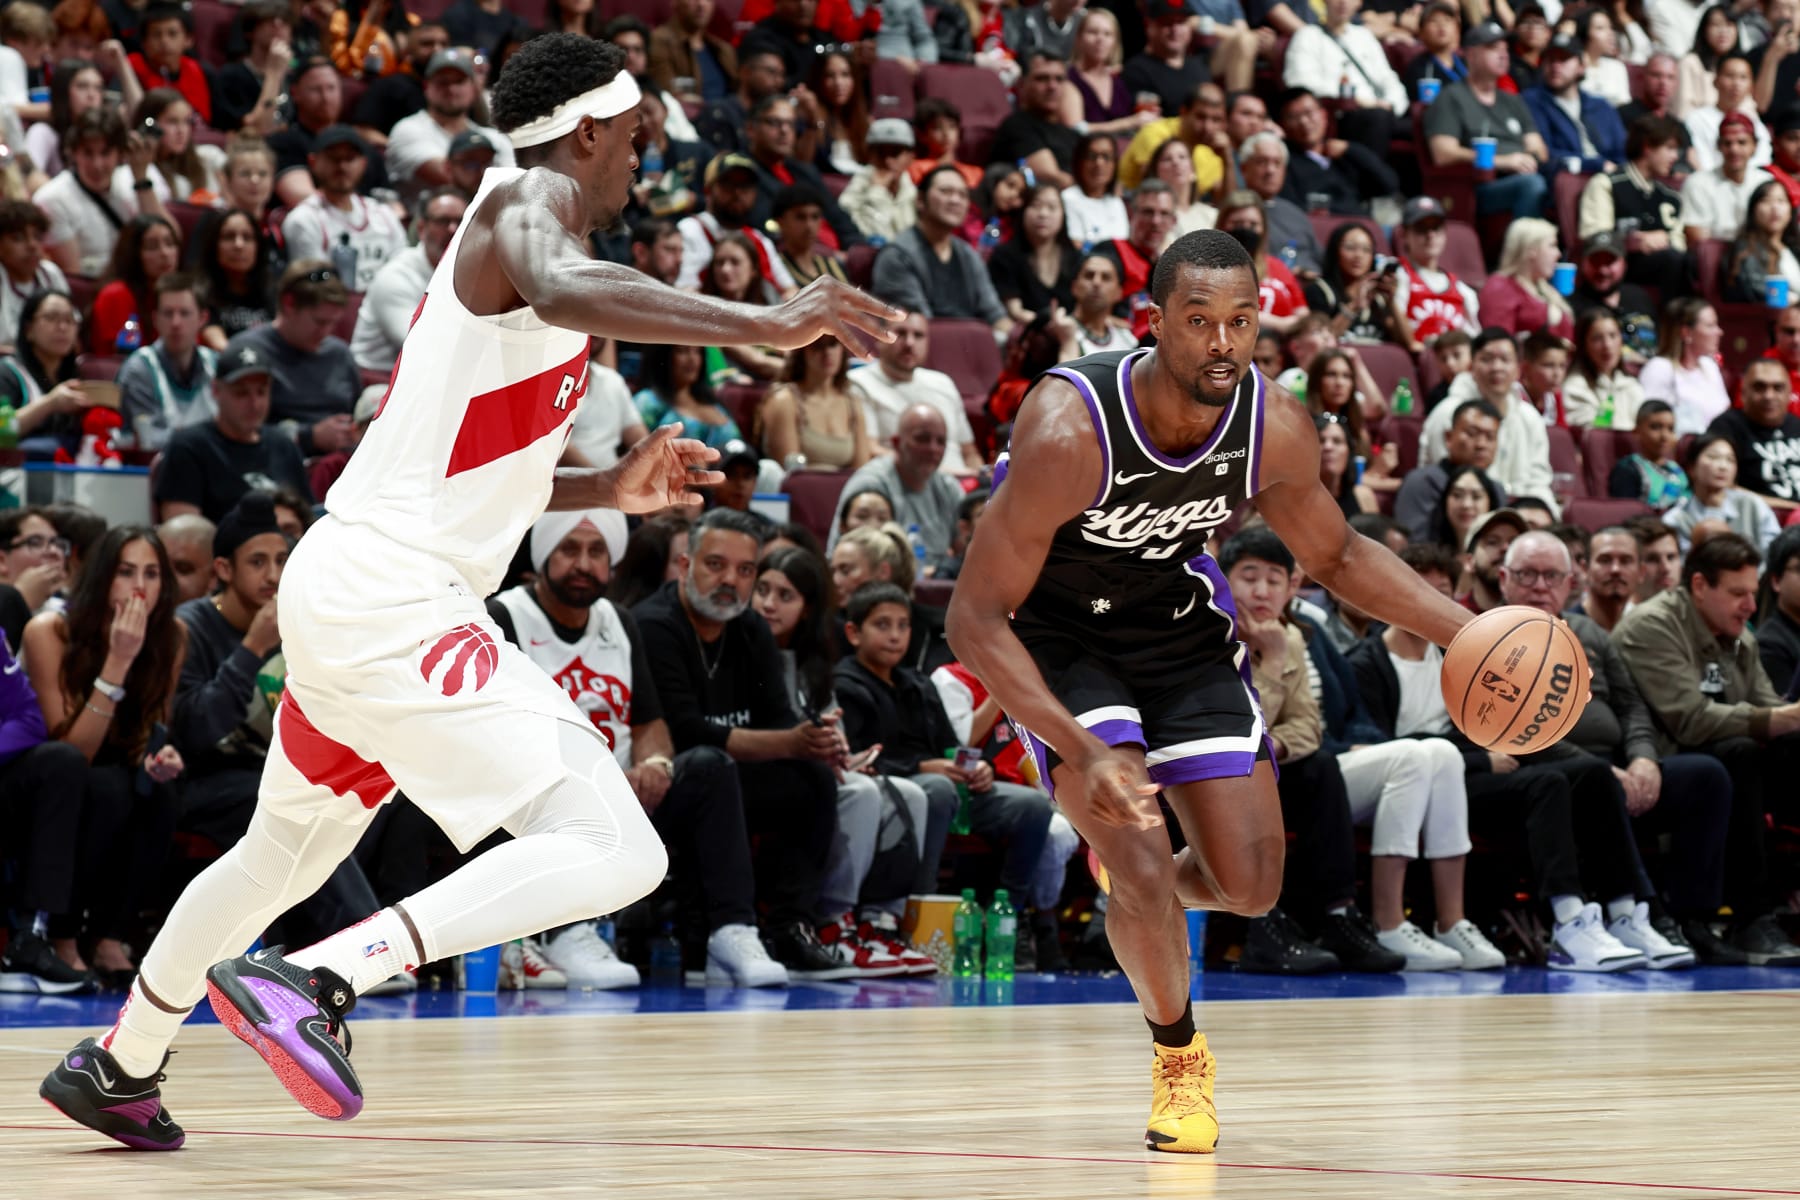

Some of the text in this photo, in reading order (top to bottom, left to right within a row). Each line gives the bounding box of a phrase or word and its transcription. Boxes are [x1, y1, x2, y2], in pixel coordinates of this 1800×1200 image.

[1205, 447, 1246, 465] dialpad
[1080, 495, 1232, 548] Kings
[1509, 663, 1573, 746] Wilson
